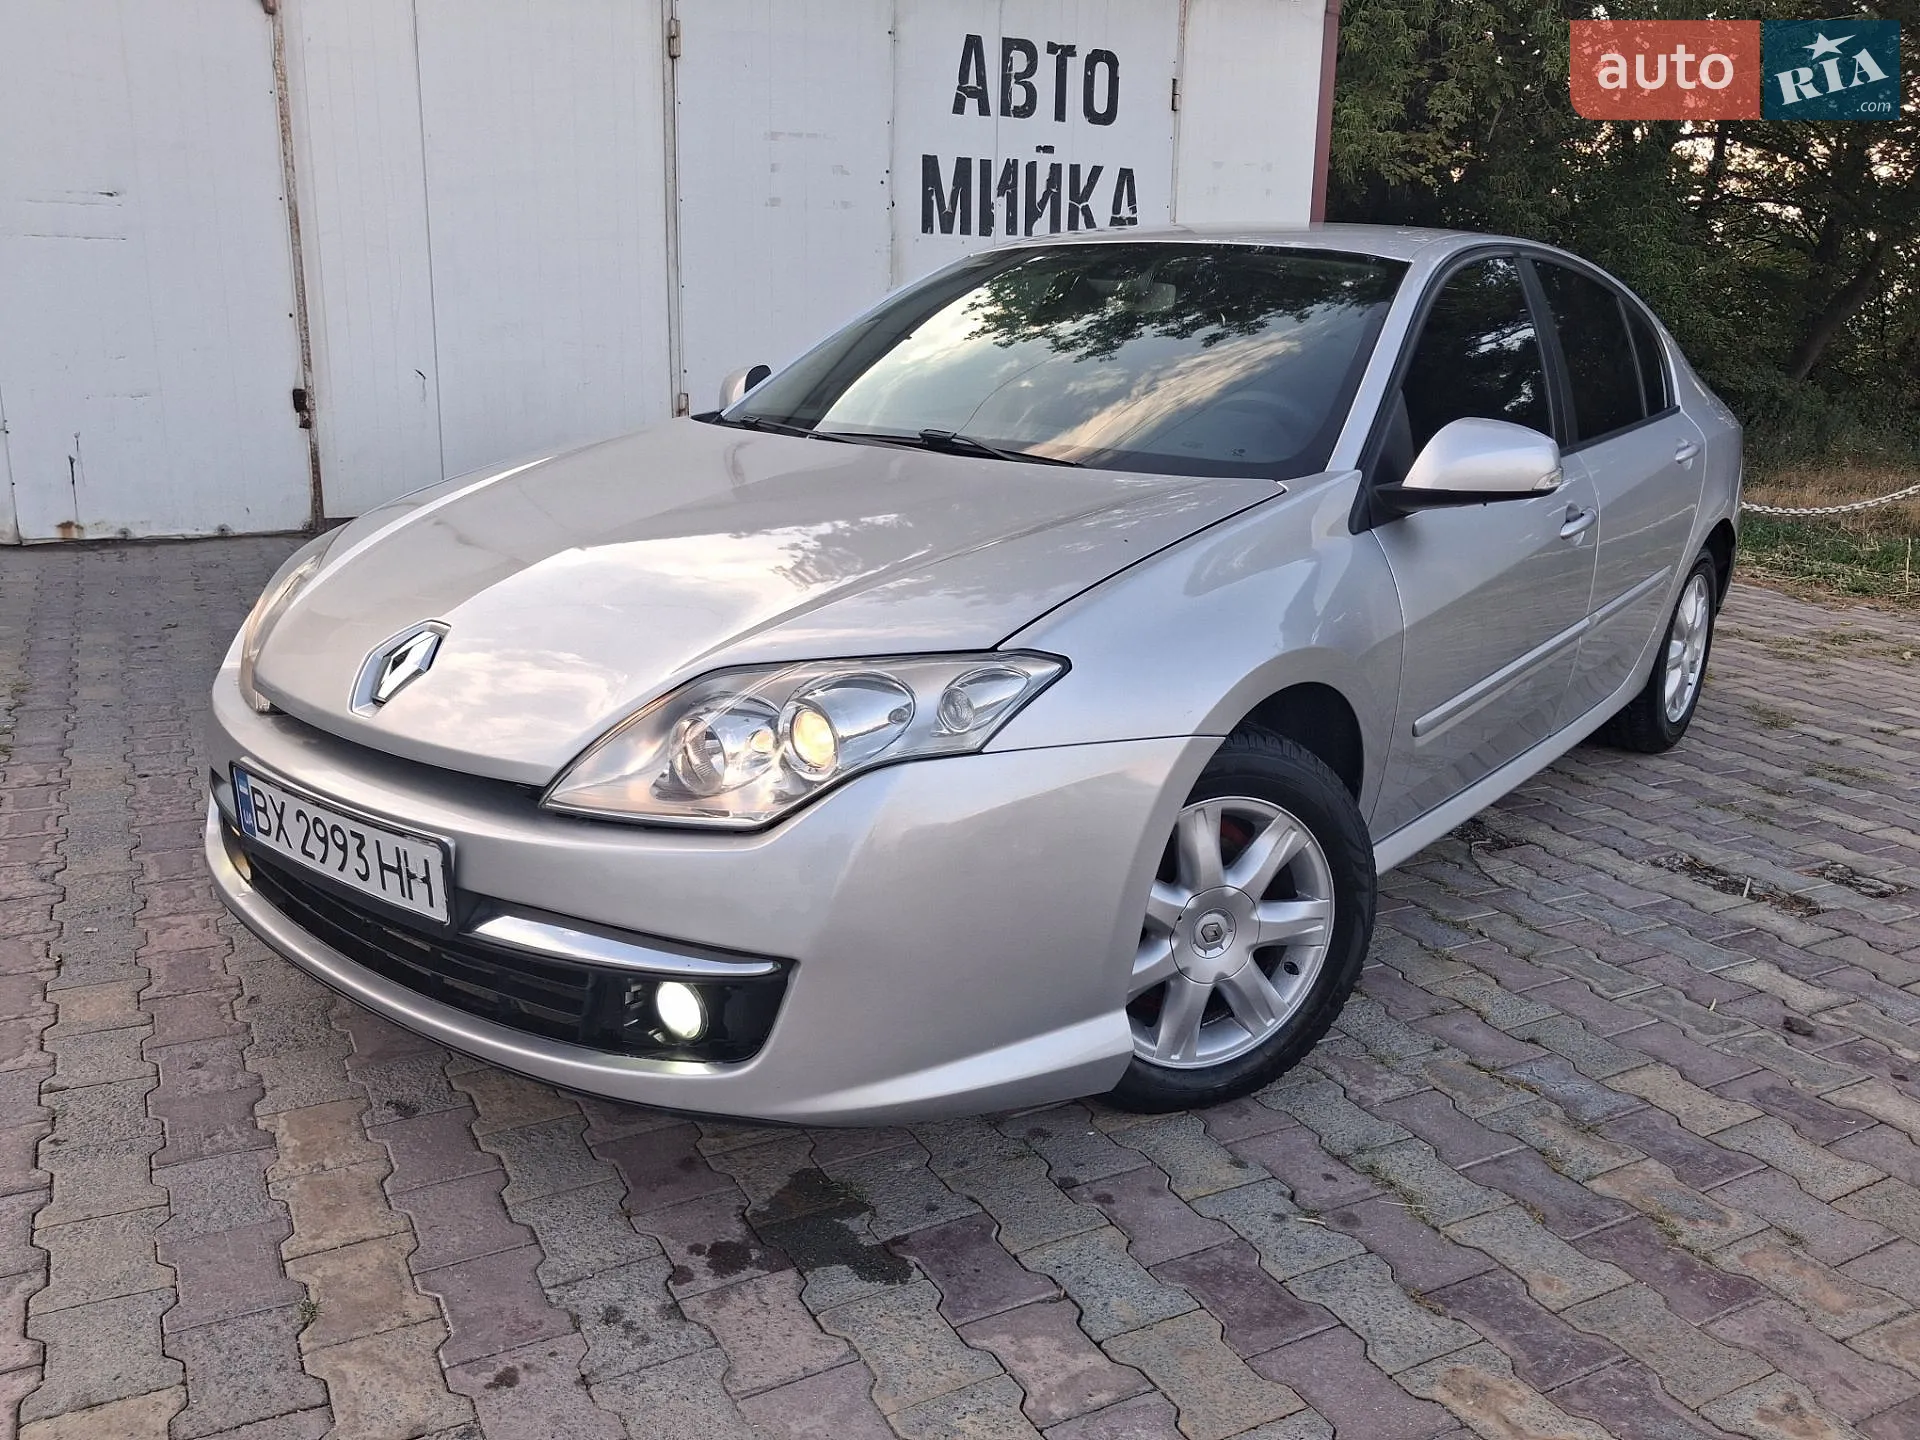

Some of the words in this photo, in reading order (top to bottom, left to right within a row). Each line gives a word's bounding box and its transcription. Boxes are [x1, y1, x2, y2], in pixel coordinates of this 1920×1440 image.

[951, 33, 1120, 126] АВТО
[921, 144, 1138, 237] МИЙКА
[250, 785, 293, 849] BX
[296, 808, 370, 882] 2993
[376, 839, 434, 908] HH
